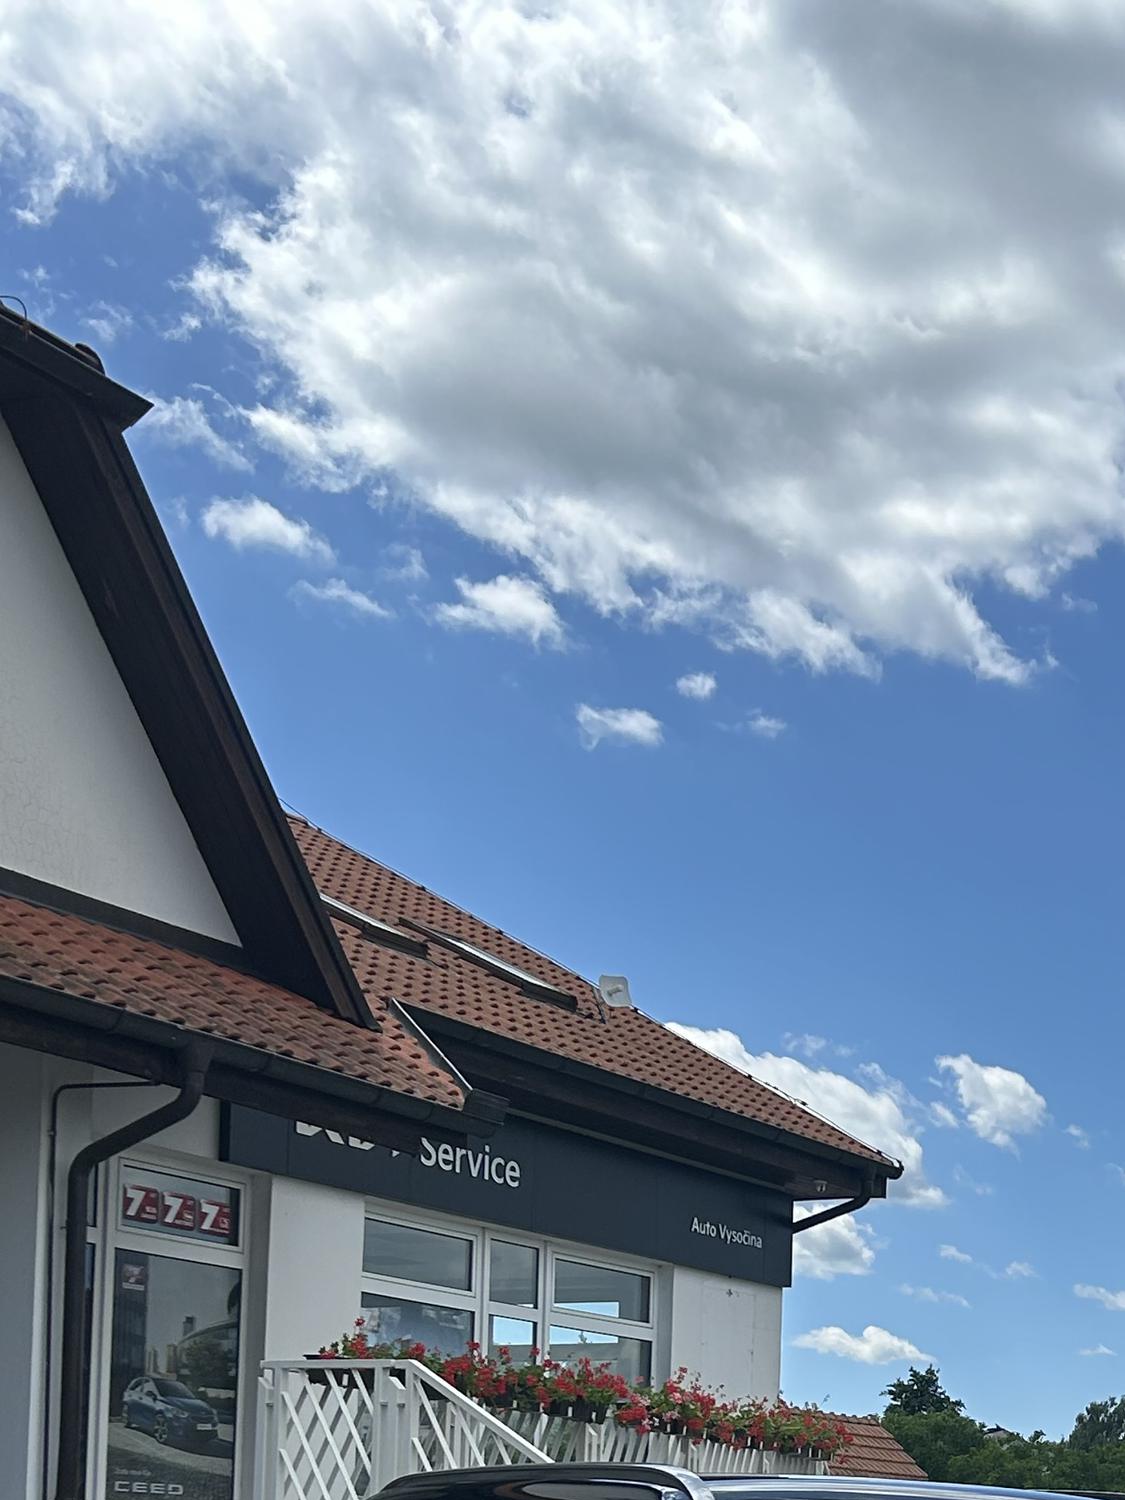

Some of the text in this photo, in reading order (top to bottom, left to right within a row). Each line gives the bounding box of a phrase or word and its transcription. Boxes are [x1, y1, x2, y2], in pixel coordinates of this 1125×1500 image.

[420, 1136, 521, 1188] Service
[691, 1217, 763, 1249] Auto Vysočina
[114, 1480, 184, 1496] CEED
